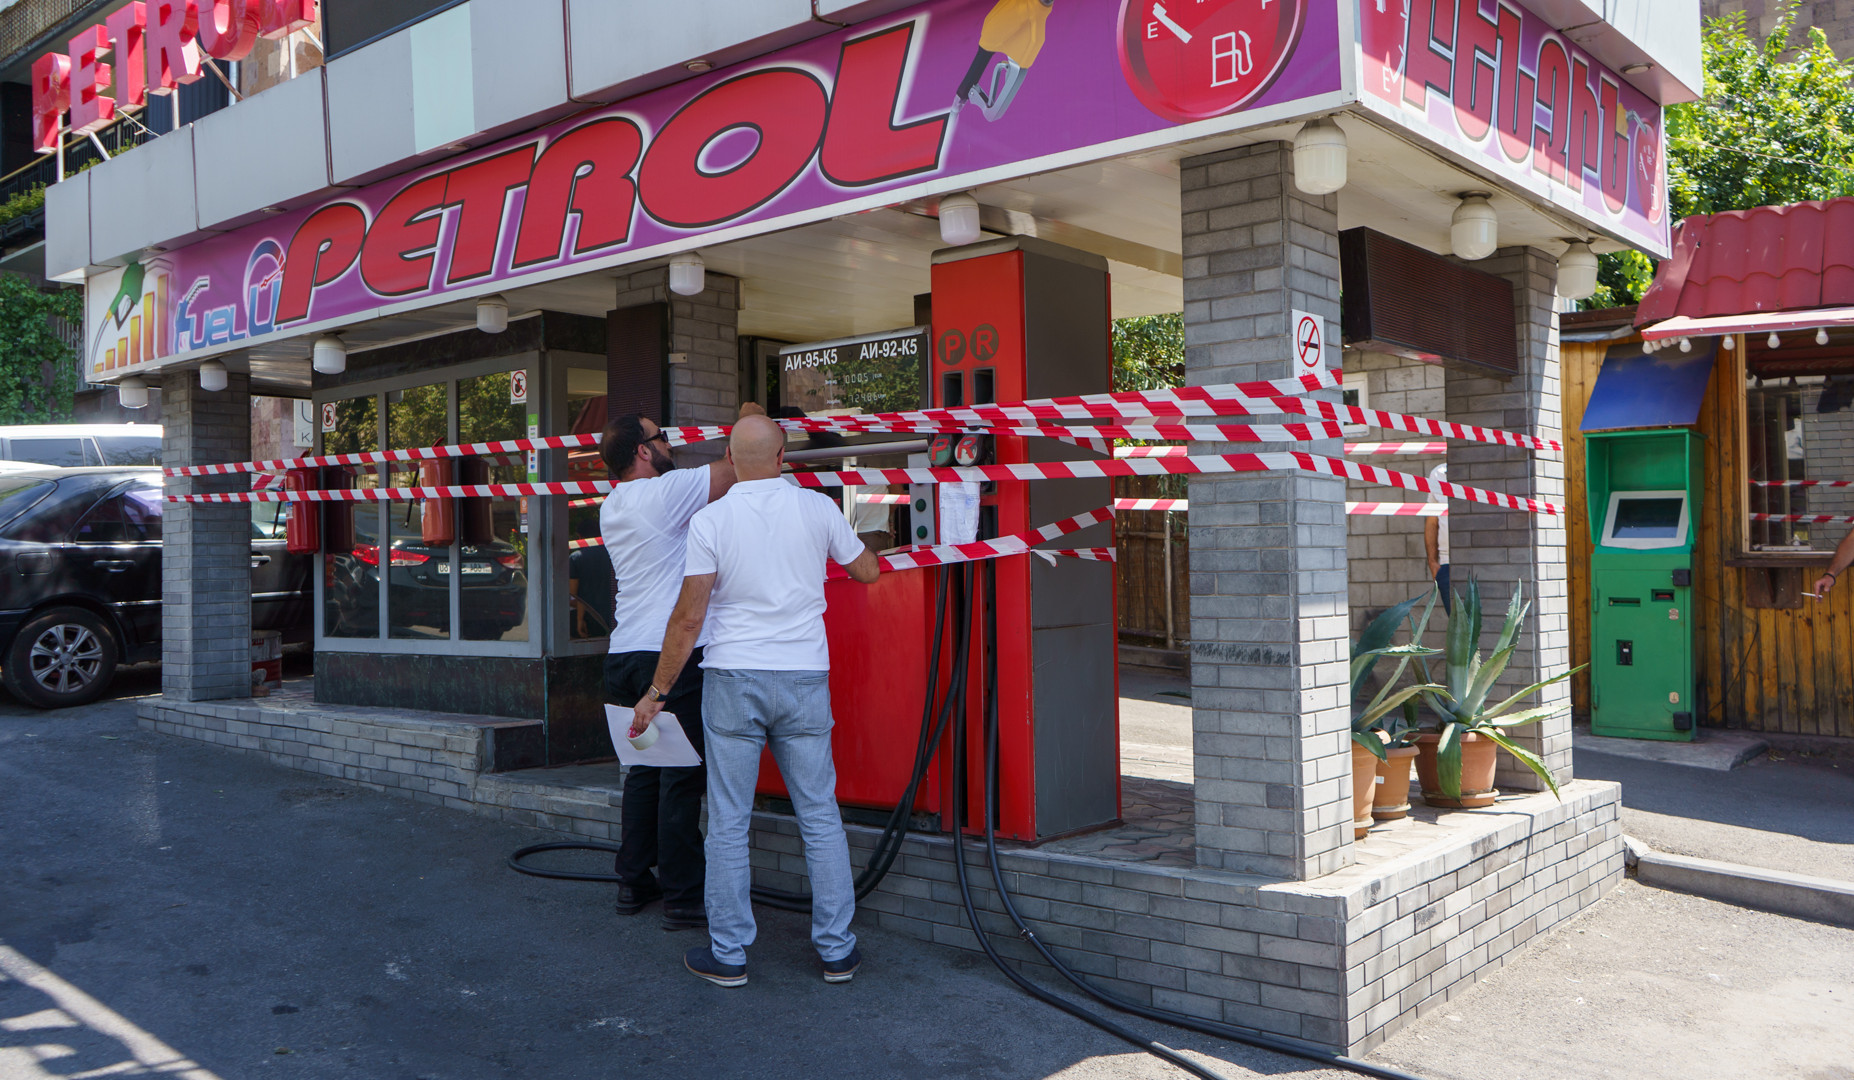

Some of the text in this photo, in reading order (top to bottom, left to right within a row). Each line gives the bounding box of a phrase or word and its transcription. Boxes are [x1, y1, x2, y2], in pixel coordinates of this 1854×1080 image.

[1148, 21, 1159, 39] E
[274, 19, 950, 326] PETROL
[785, 338, 918, 371] АИ-95-К5 АИ-92-К5
[945, 329, 994, 361] P R
[931, 437, 977, 461] P R
